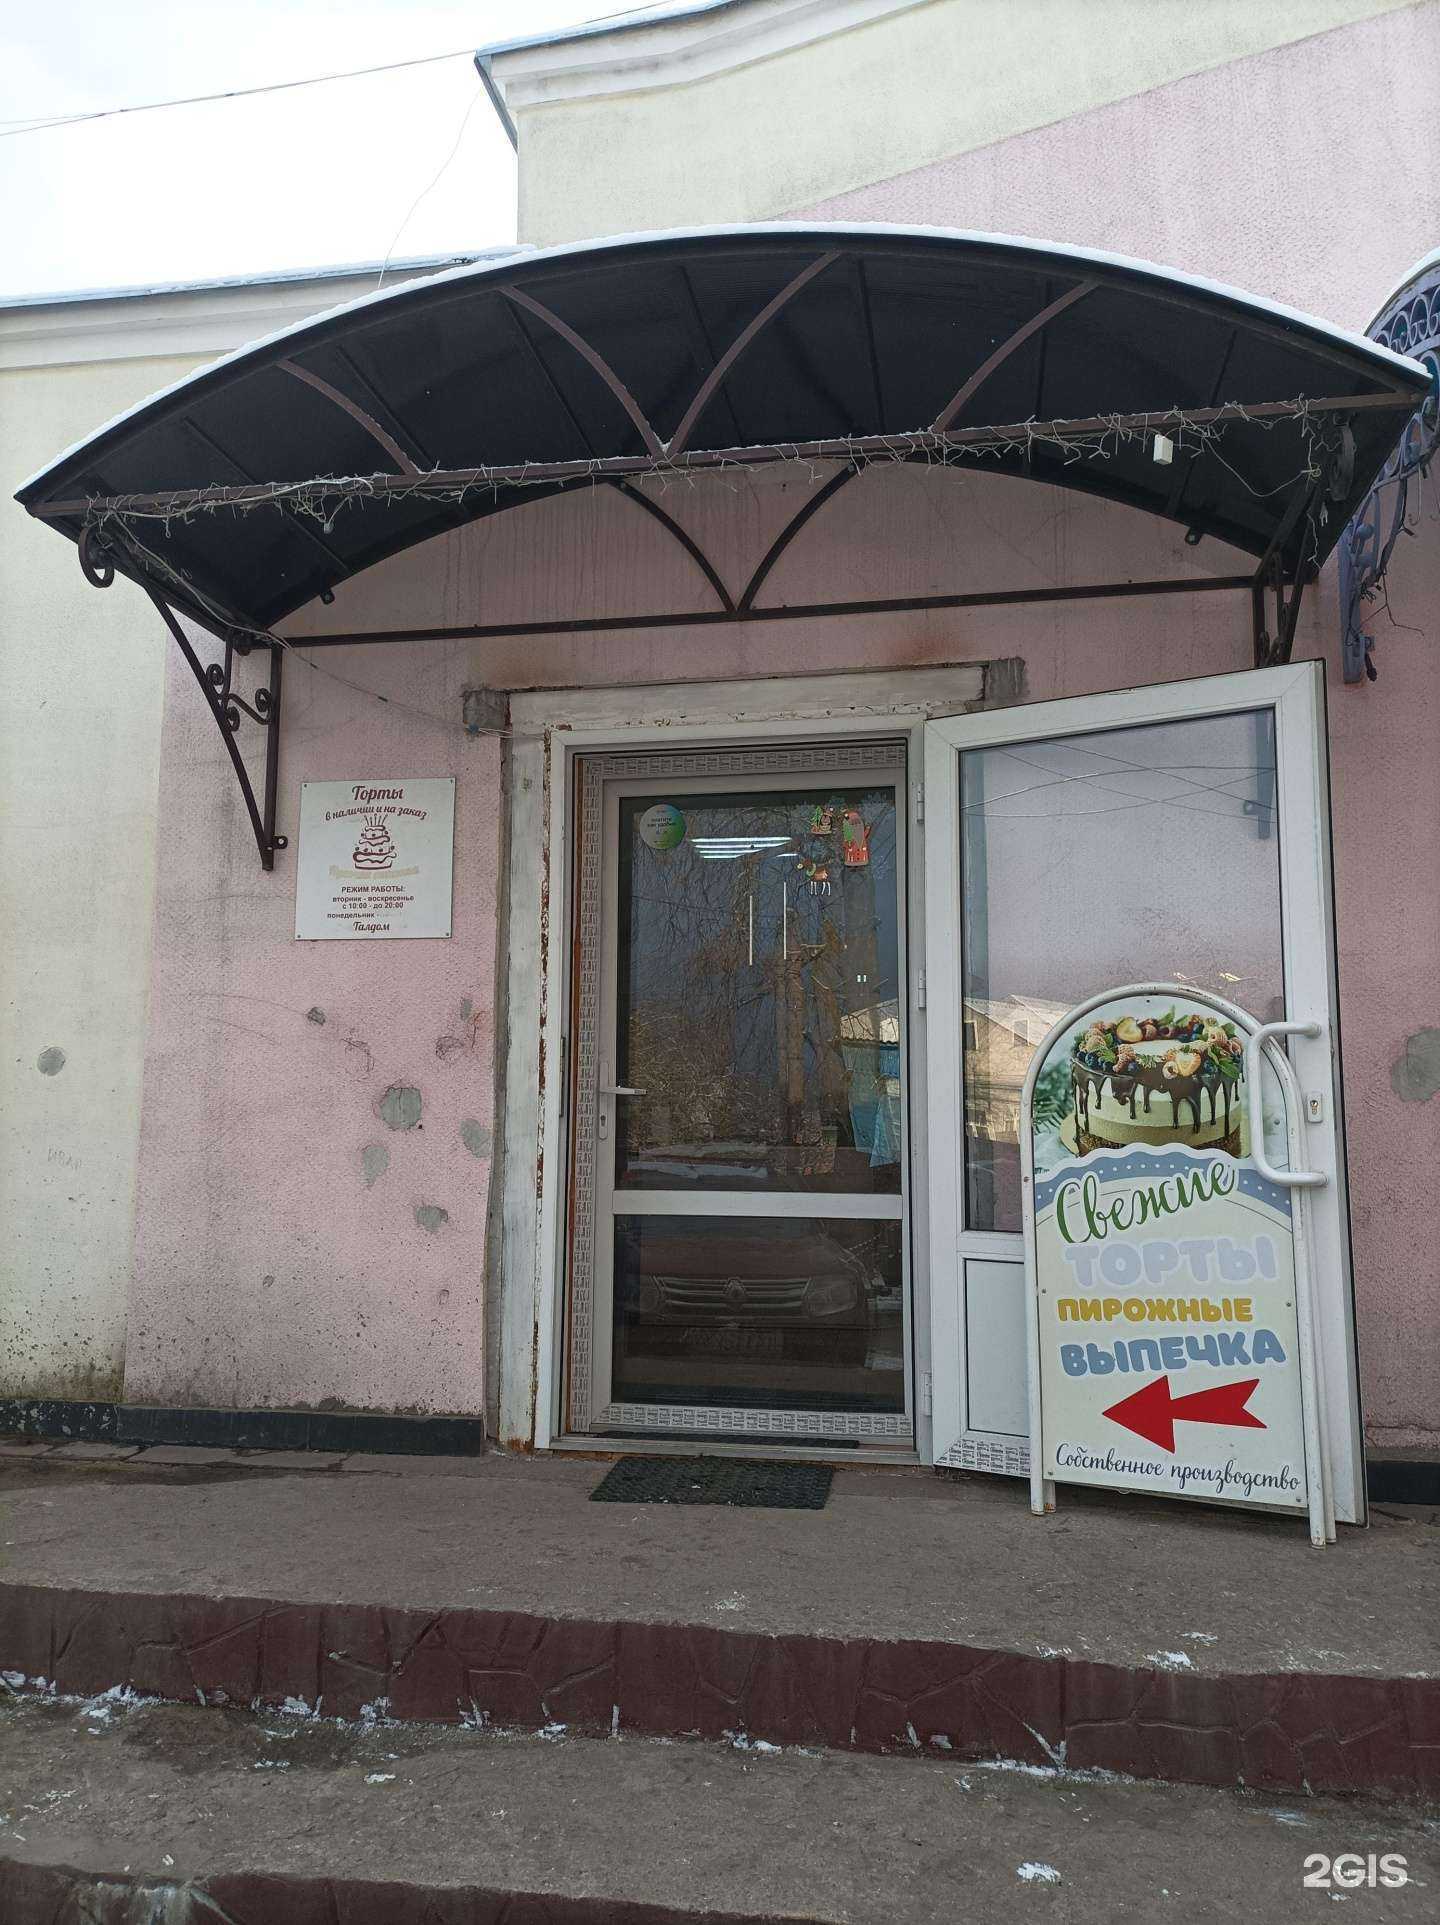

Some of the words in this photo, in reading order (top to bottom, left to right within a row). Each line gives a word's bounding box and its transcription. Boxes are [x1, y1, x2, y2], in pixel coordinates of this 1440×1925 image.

[352, 785, 404, 804] Торты
[325, 811, 332, 821] в
[333, 805, 375, 819] наличии
[383, 805, 396, 813] на
[397, 807, 427, 821] заказ
[367, 895, 415, 903] воскресенье
[327, 912, 375, 920] понедельник
[353, 921, 390, 933] Талдом
[1056, 1162, 1236, 1244] Свежие
[1064, 1234, 1279, 1288] ТОРТЫ
[1057, 1297, 1254, 1322] ПИРОЖНЫЕ
[1060, 1328, 1287, 1377] ВЫПЕЧКА
[1055, 1442, 1165, 1477] Собственное
[1170, 1458, 1301, 1496] производство
